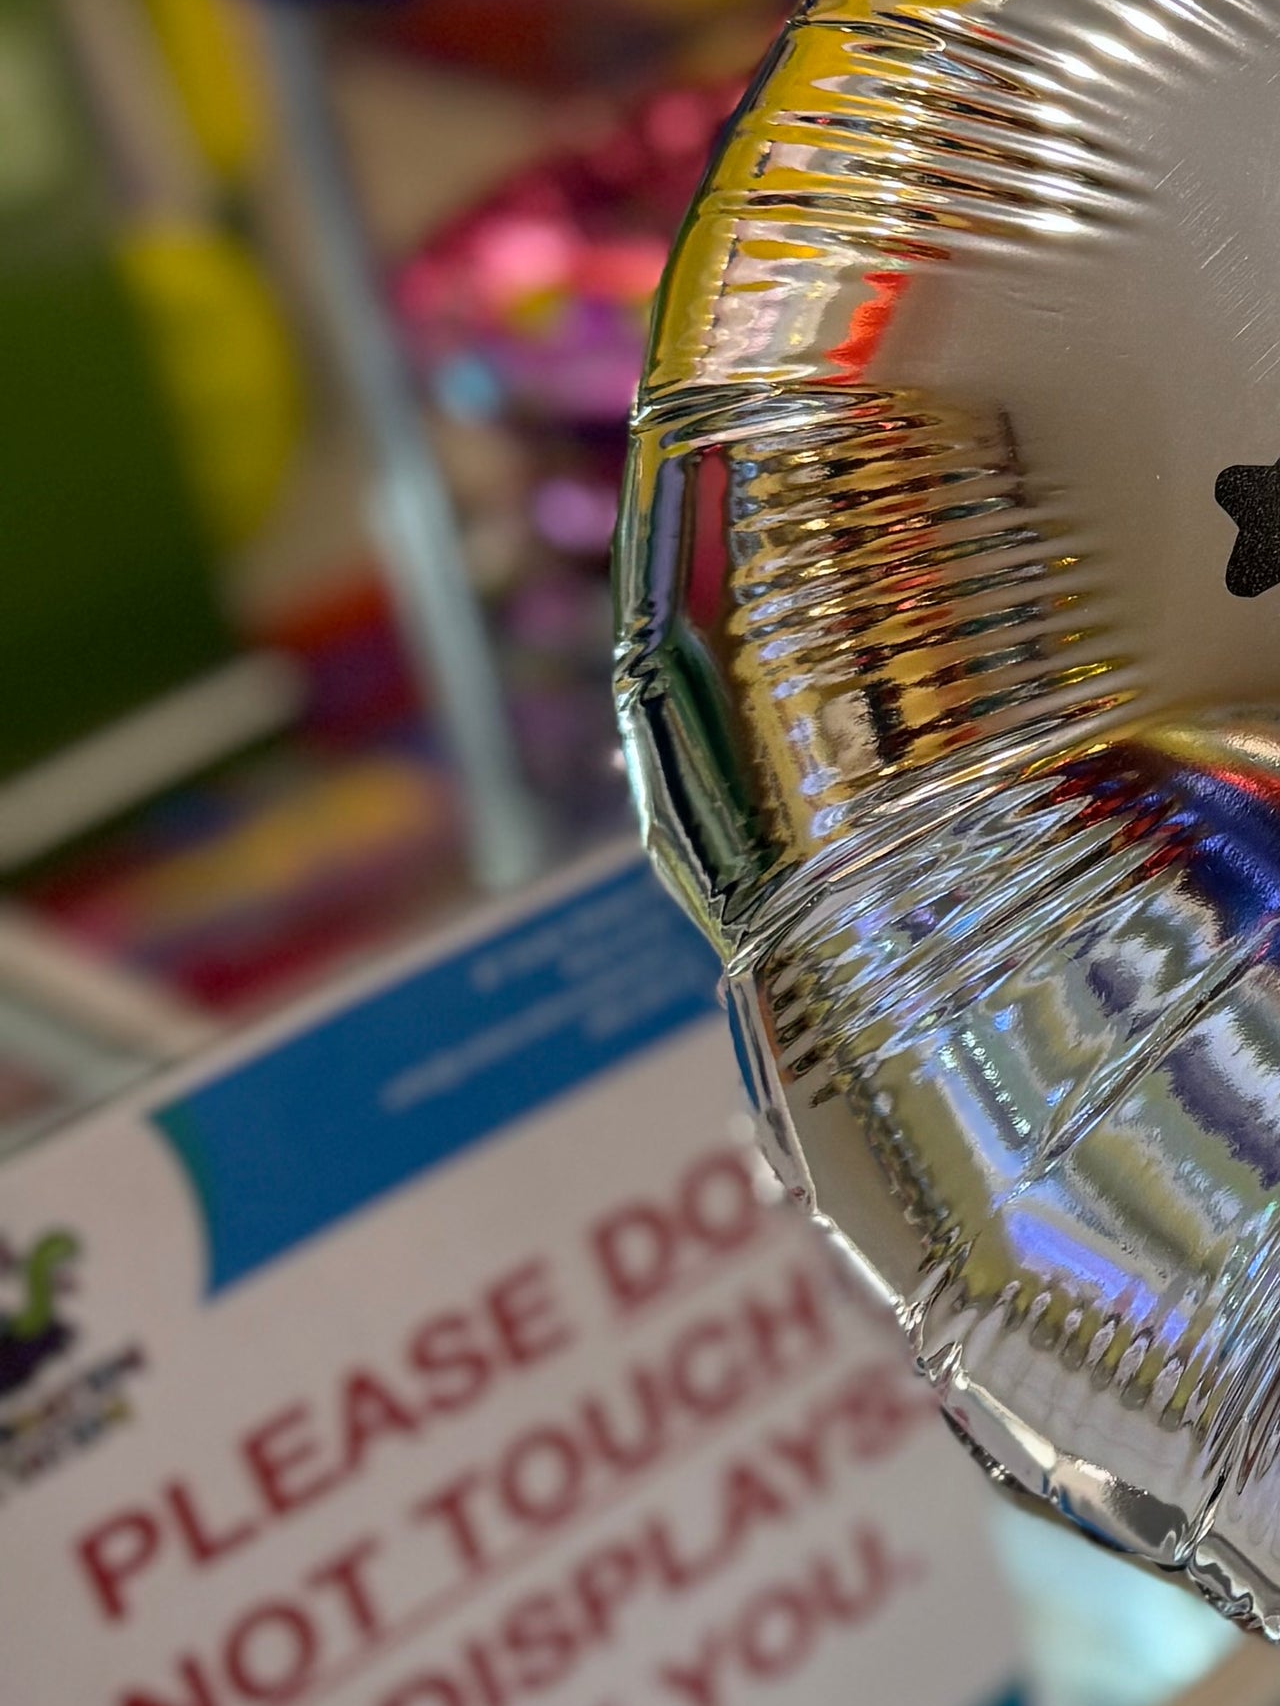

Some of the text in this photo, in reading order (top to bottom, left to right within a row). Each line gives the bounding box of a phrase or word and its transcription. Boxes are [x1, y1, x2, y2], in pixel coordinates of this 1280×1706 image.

[76, 1255, 576, 1629] PLEASE
[588, 1143, 766, 1317] DO
[407, 1265, 834, 1585] TOUCH
